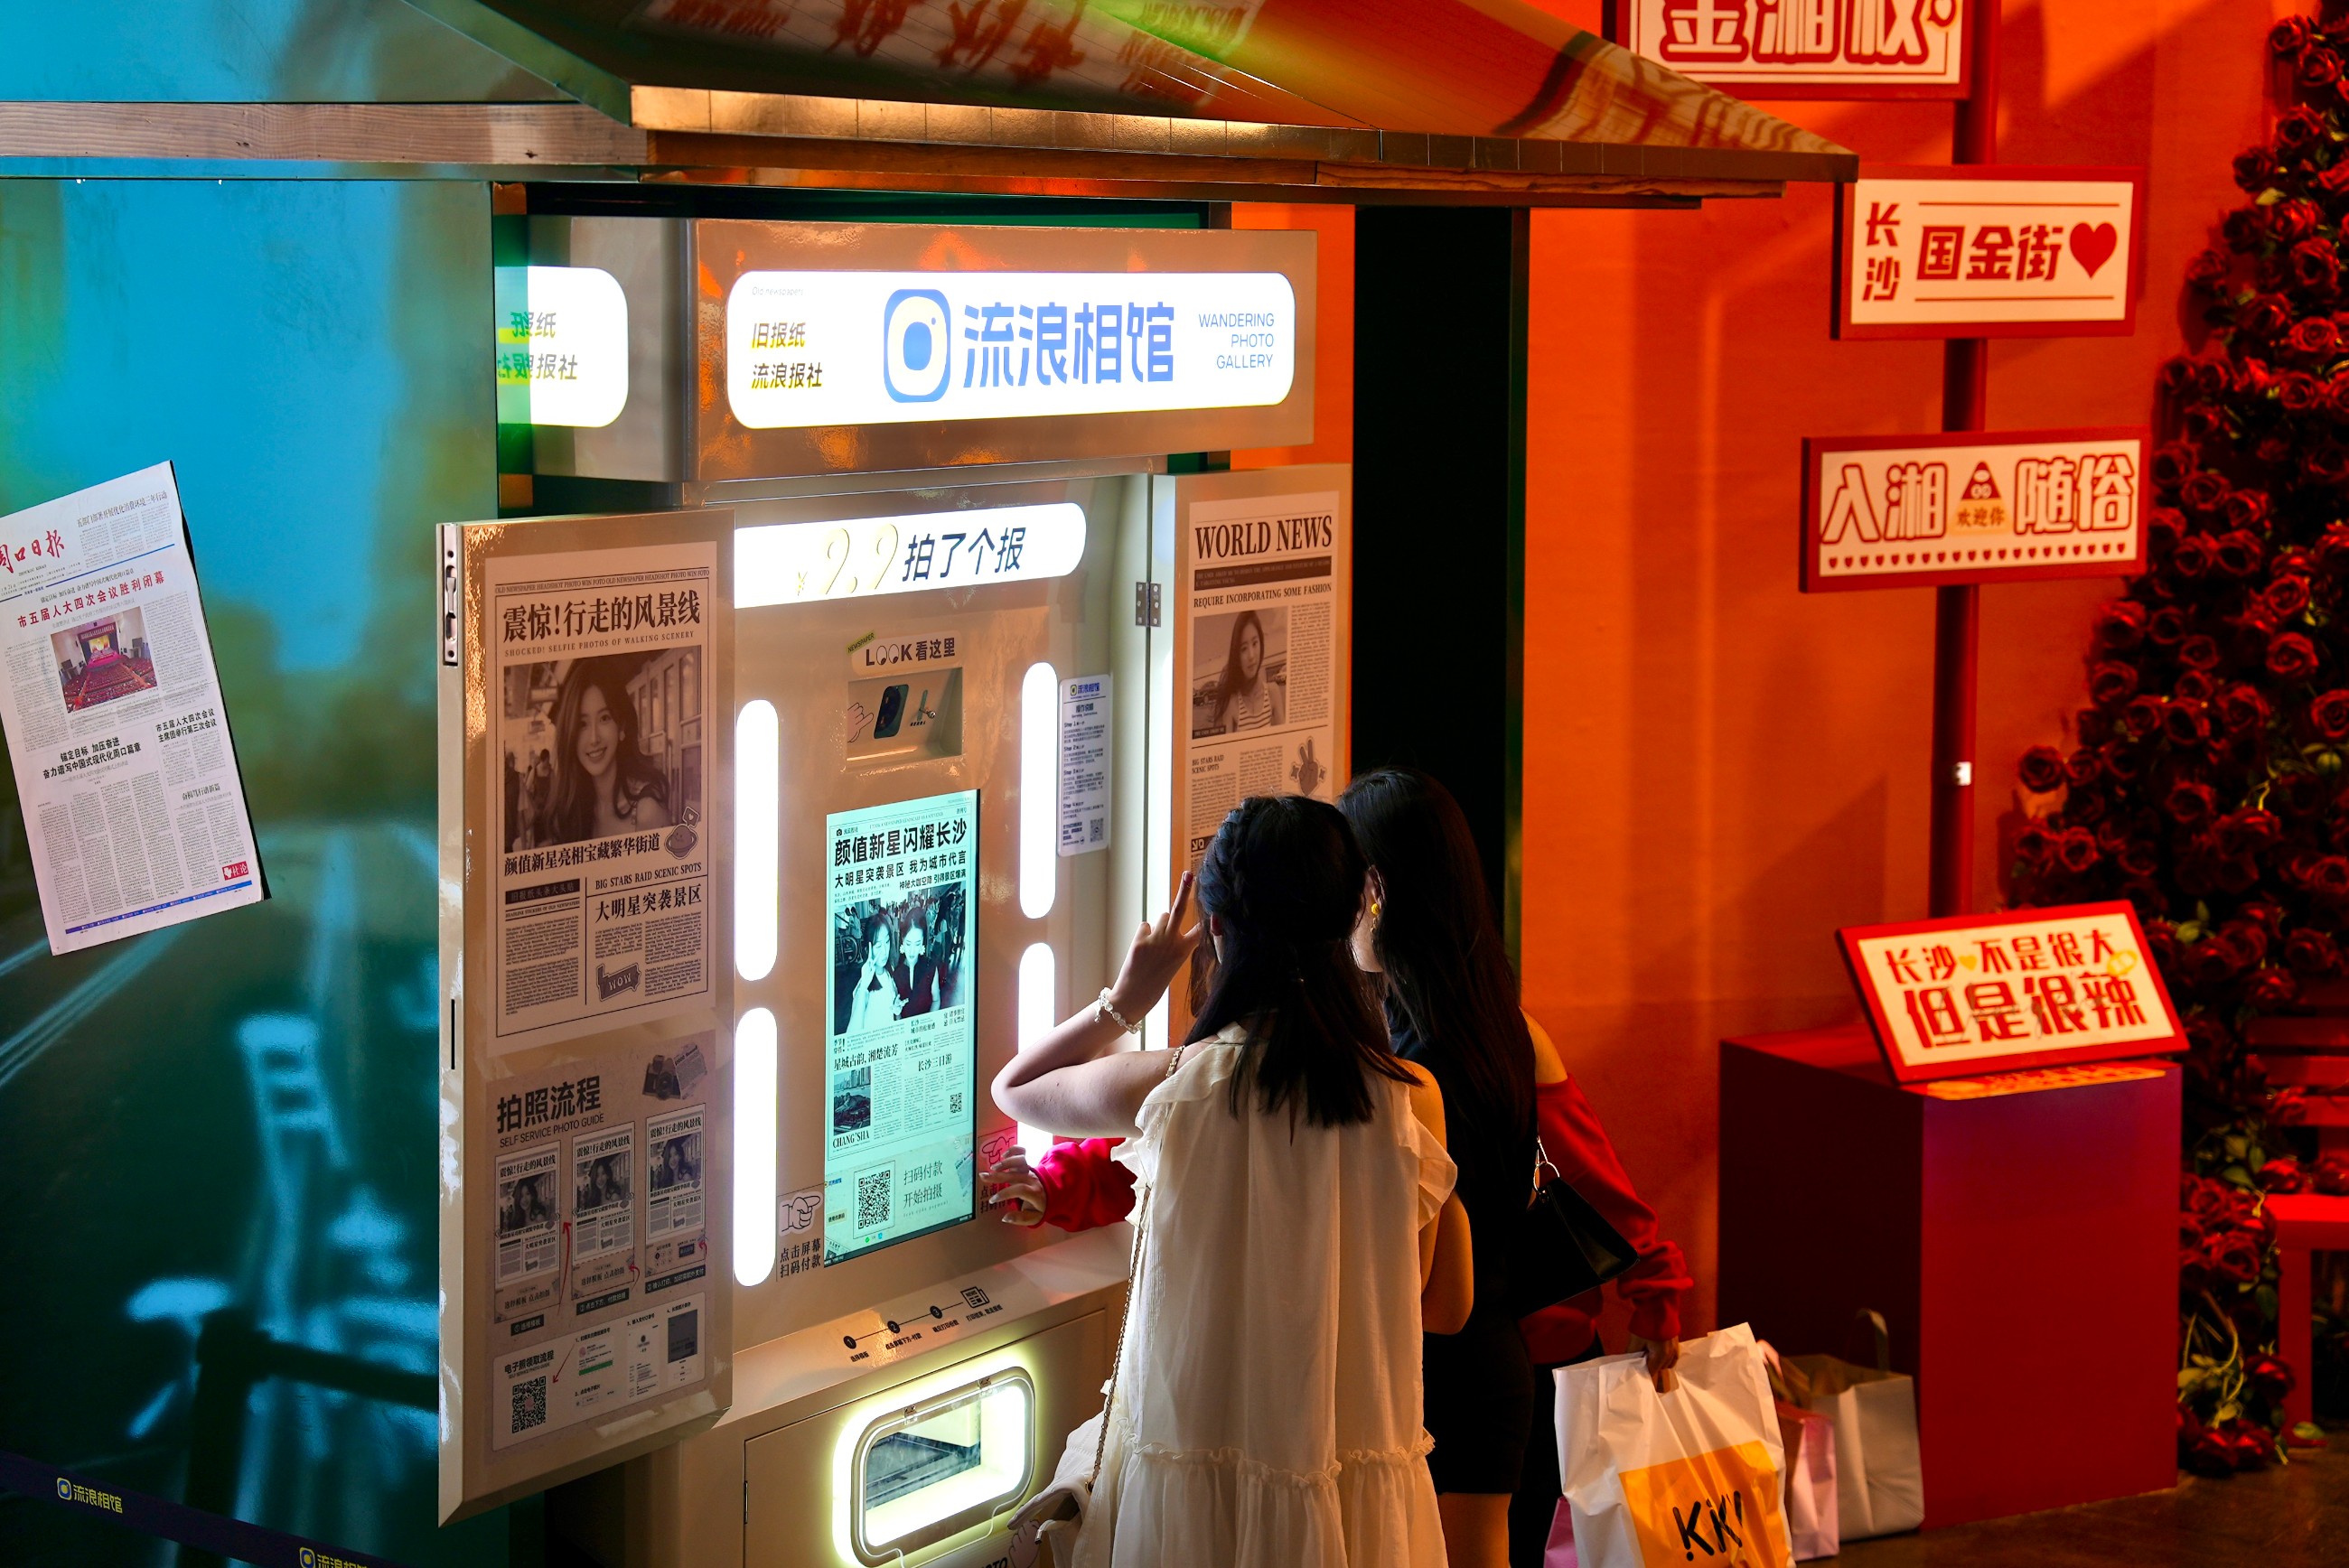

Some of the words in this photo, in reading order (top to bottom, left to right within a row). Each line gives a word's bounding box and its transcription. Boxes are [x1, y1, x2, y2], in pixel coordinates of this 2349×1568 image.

[1862, 201, 1901, 301] 长沙
[1916, 224, 2064, 282] 国金街
[1198, 313, 1275, 328] WANDERING
[752, 322, 806, 349] 旧报纸
[963, 301, 1174, 388] 流浪相馆
[1231, 333, 1275, 348] PHOTO
[752, 362, 823, 388] 流浪报社
[1216, 354, 1274, 369] GALLERY
[1820, 462, 1948, 545] 入湘
[2013, 453, 2135, 537] 随俗
[1956, 504, 2005, 529] 欢迎你
[1195, 521, 1271, 559] WORLD
[1276, 515, 1333, 552] NEWS
[902, 527, 1026, 582] 拍了个报
[507, 583, 536, 593] NEWSPAPER
[537, 581, 564, 590] HEADSHOT
[564, 580, 582, 588] PHOTO
[617, 574, 644, 583] NEWSPAPER
[645, 573, 670, 582] HEADSHOT
[687, 570, 697, 578] WIN
[17, 570, 164, 629] 市五届人大四次会议胜利闭幕
[1193, 595, 1224, 609] REQUIRE
[1226, 588, 1282, 604] INCORPORATING
[1283, 586, 1302, 597] SOME
[1304, 583, 1332, 594] FASHION
[503, 590, 700, 643] 震惊!行走的风景线
[505, 646, 545, 658] SHOCKED!
[548, 642, 576, 653] SELFIE
[579, 639, 609, 649] PHOTOS
[612, 638, 622, 646] OF
[624, 634, 659, 644] WALKING
[661, 630, 695, 640] SCENERY
[847, 632, 875, 653] NEWSPAPER
[915, 637, 955, 661] 看这里
[155, 708, 215, 733] 市五届人大四次会议
[158, 718, 218, 743] 主席团举行第三次会议
[42, 742, 142, 779] 奋力谱写中国式现代化周口篇章
[60, 745, 89, 762] 锚定目标
[91, 736, 120, 753] 加压奋进
[1201, 756, 1213, 765] STARS
[1192, 765, 1206, 774] SCENIC
[1207, 763, 1220, 772] SPOTS
[504, 833, 660, 877] 颜值新星亮相宝藏繁华街道
[835, 817, 968, 867] 颜值新星闪耀长沙
[595, 879, 608, 891] BIG
[610, 874, 632, 887] STARS
[634, 871, 652, 883] RAID
[654, 866, 679, 880] SCENIC
[680, 862, 702, 874] SPOTS
[835, 862, 904, 889] 大明星突袭景区
[909, 850, 967, 874] 我为城市代言
[594, 883, 702, 924] 大明星突袭景区
[1885, 945, 1957, 985] 长沙
[1972, 929, 2116, 975] 不是很大
[608, 972, 632, 991] WOW
[1904, 971, 2148, 1049] 但是很辣
[918, 1053, 952, 1072] 长沙三日游
[497, 1075, 602, 1134] 拍照流程
[500, 1137, 519, 1148] SELF
[519, 1129, 552, 1143] SERVICE
[553, 1121, 579, 1134] PHOTO
[582, 1113, 604, 1128] GUIDE
[832, 1129, 870, 1149] CHANG'SHA
[903, 1160, 943, 1186] 扫码付款
[903, 1182, 942, 1209] 开始拍摄
[780, 1237, 821, 1263] 点击屏幕
[780, 1254, 821, 1278] 扫码付款
[504, 1349, 555, 1374] 电子照领取流程
[73, 1483, 124, 1514] 流浪相馆
